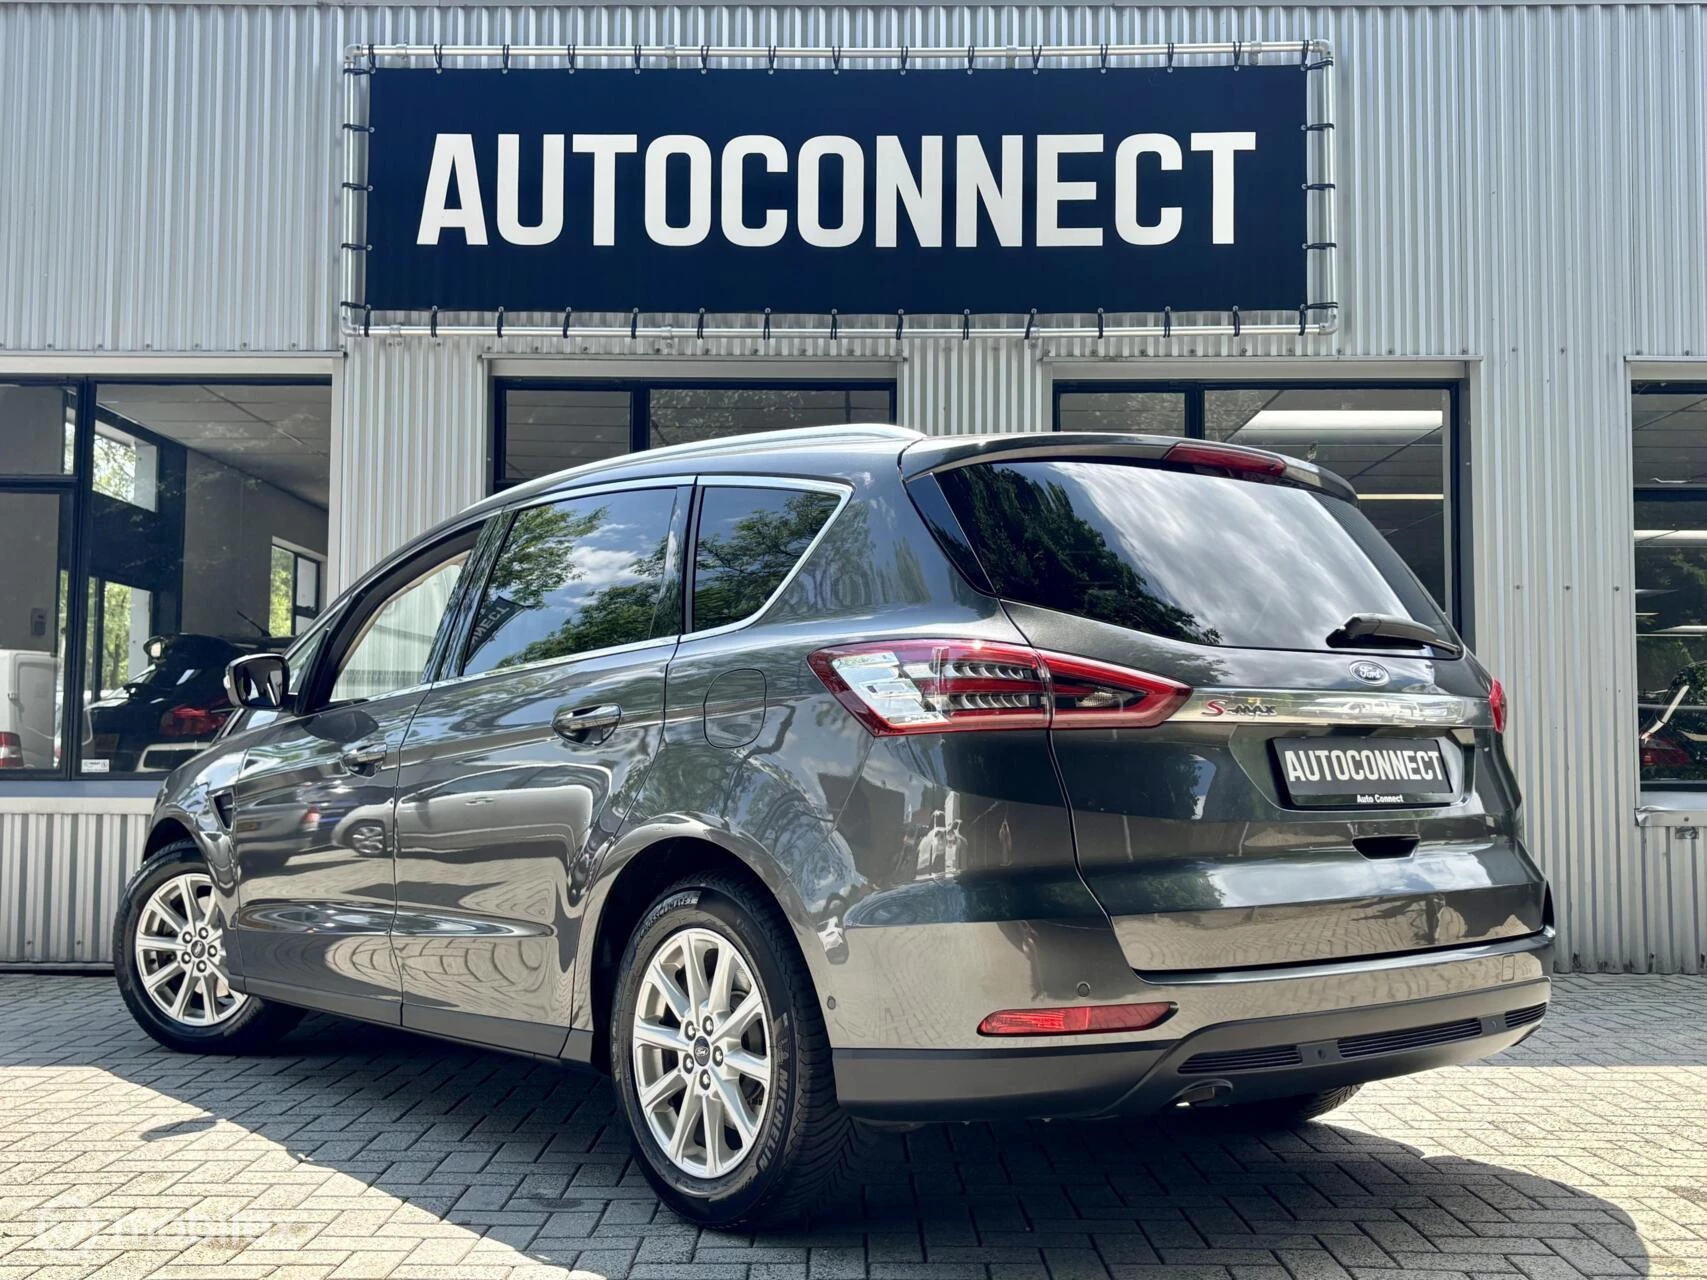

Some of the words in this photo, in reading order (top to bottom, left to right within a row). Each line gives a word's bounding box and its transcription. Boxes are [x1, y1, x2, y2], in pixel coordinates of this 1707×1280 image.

[416, 131, 1257, 249] AUTOCONNECT
[1284, 749, 1443, 782] AUTOCONNECT
[1356, 794, 1374, 803] Auto
[1375, 794, 1404, 803] Connect
[756, 1068, 789, 1174] MICHELIN
